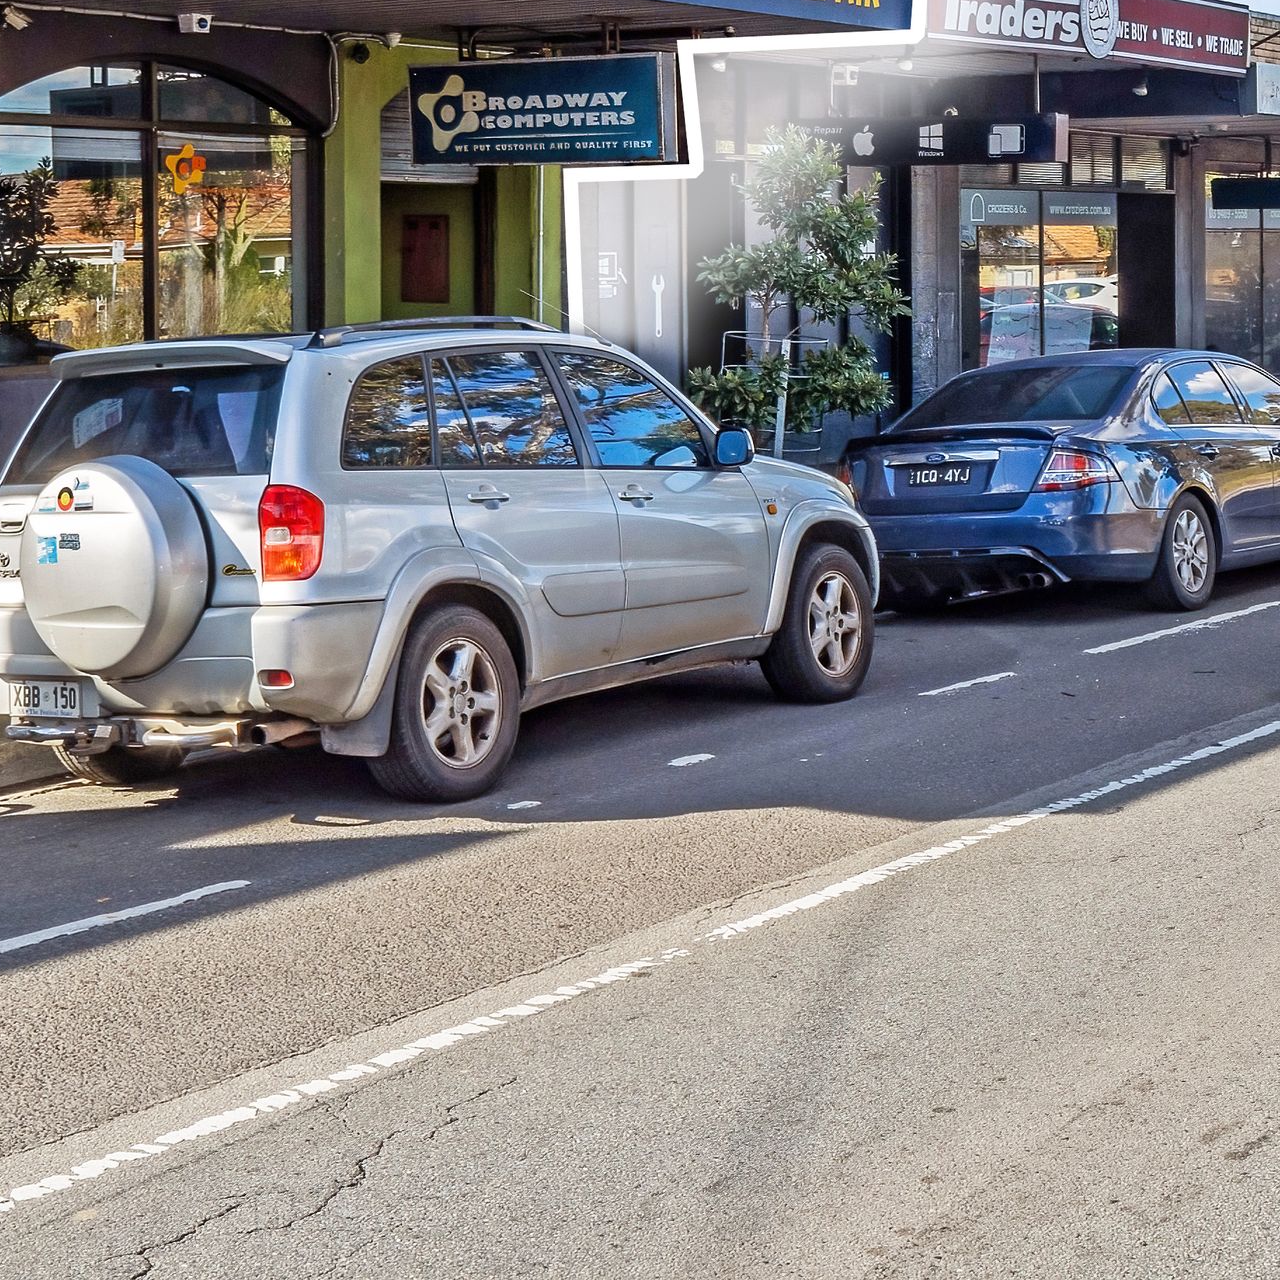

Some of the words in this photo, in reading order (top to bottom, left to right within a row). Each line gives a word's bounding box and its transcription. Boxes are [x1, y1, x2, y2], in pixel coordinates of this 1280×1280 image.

[1131, 22, 1148, 42] BUY
[1161, 27, 1175, 46] WE
[1176, 30, 1194, 49] SELL
[1206, 34, 1218, 53] WE
[1220, 38, 1243, 56] TRADE
[462, 90, 628, 112] BROADWAY
[481, 111, 636, 129] COMPUTERS
[454, 144, 469, 152] WE
[473, 144, 491, 152] PUT
[495, 143, 545, 151] CUSTOMER
[549, 142, 571, 150] AND
[575, 141, 618, 150] QUALITY
[623, 140, 653, 149] FIRST
[14, 686, 40, 707] XBB
[53, 686, 76, 709] 150
